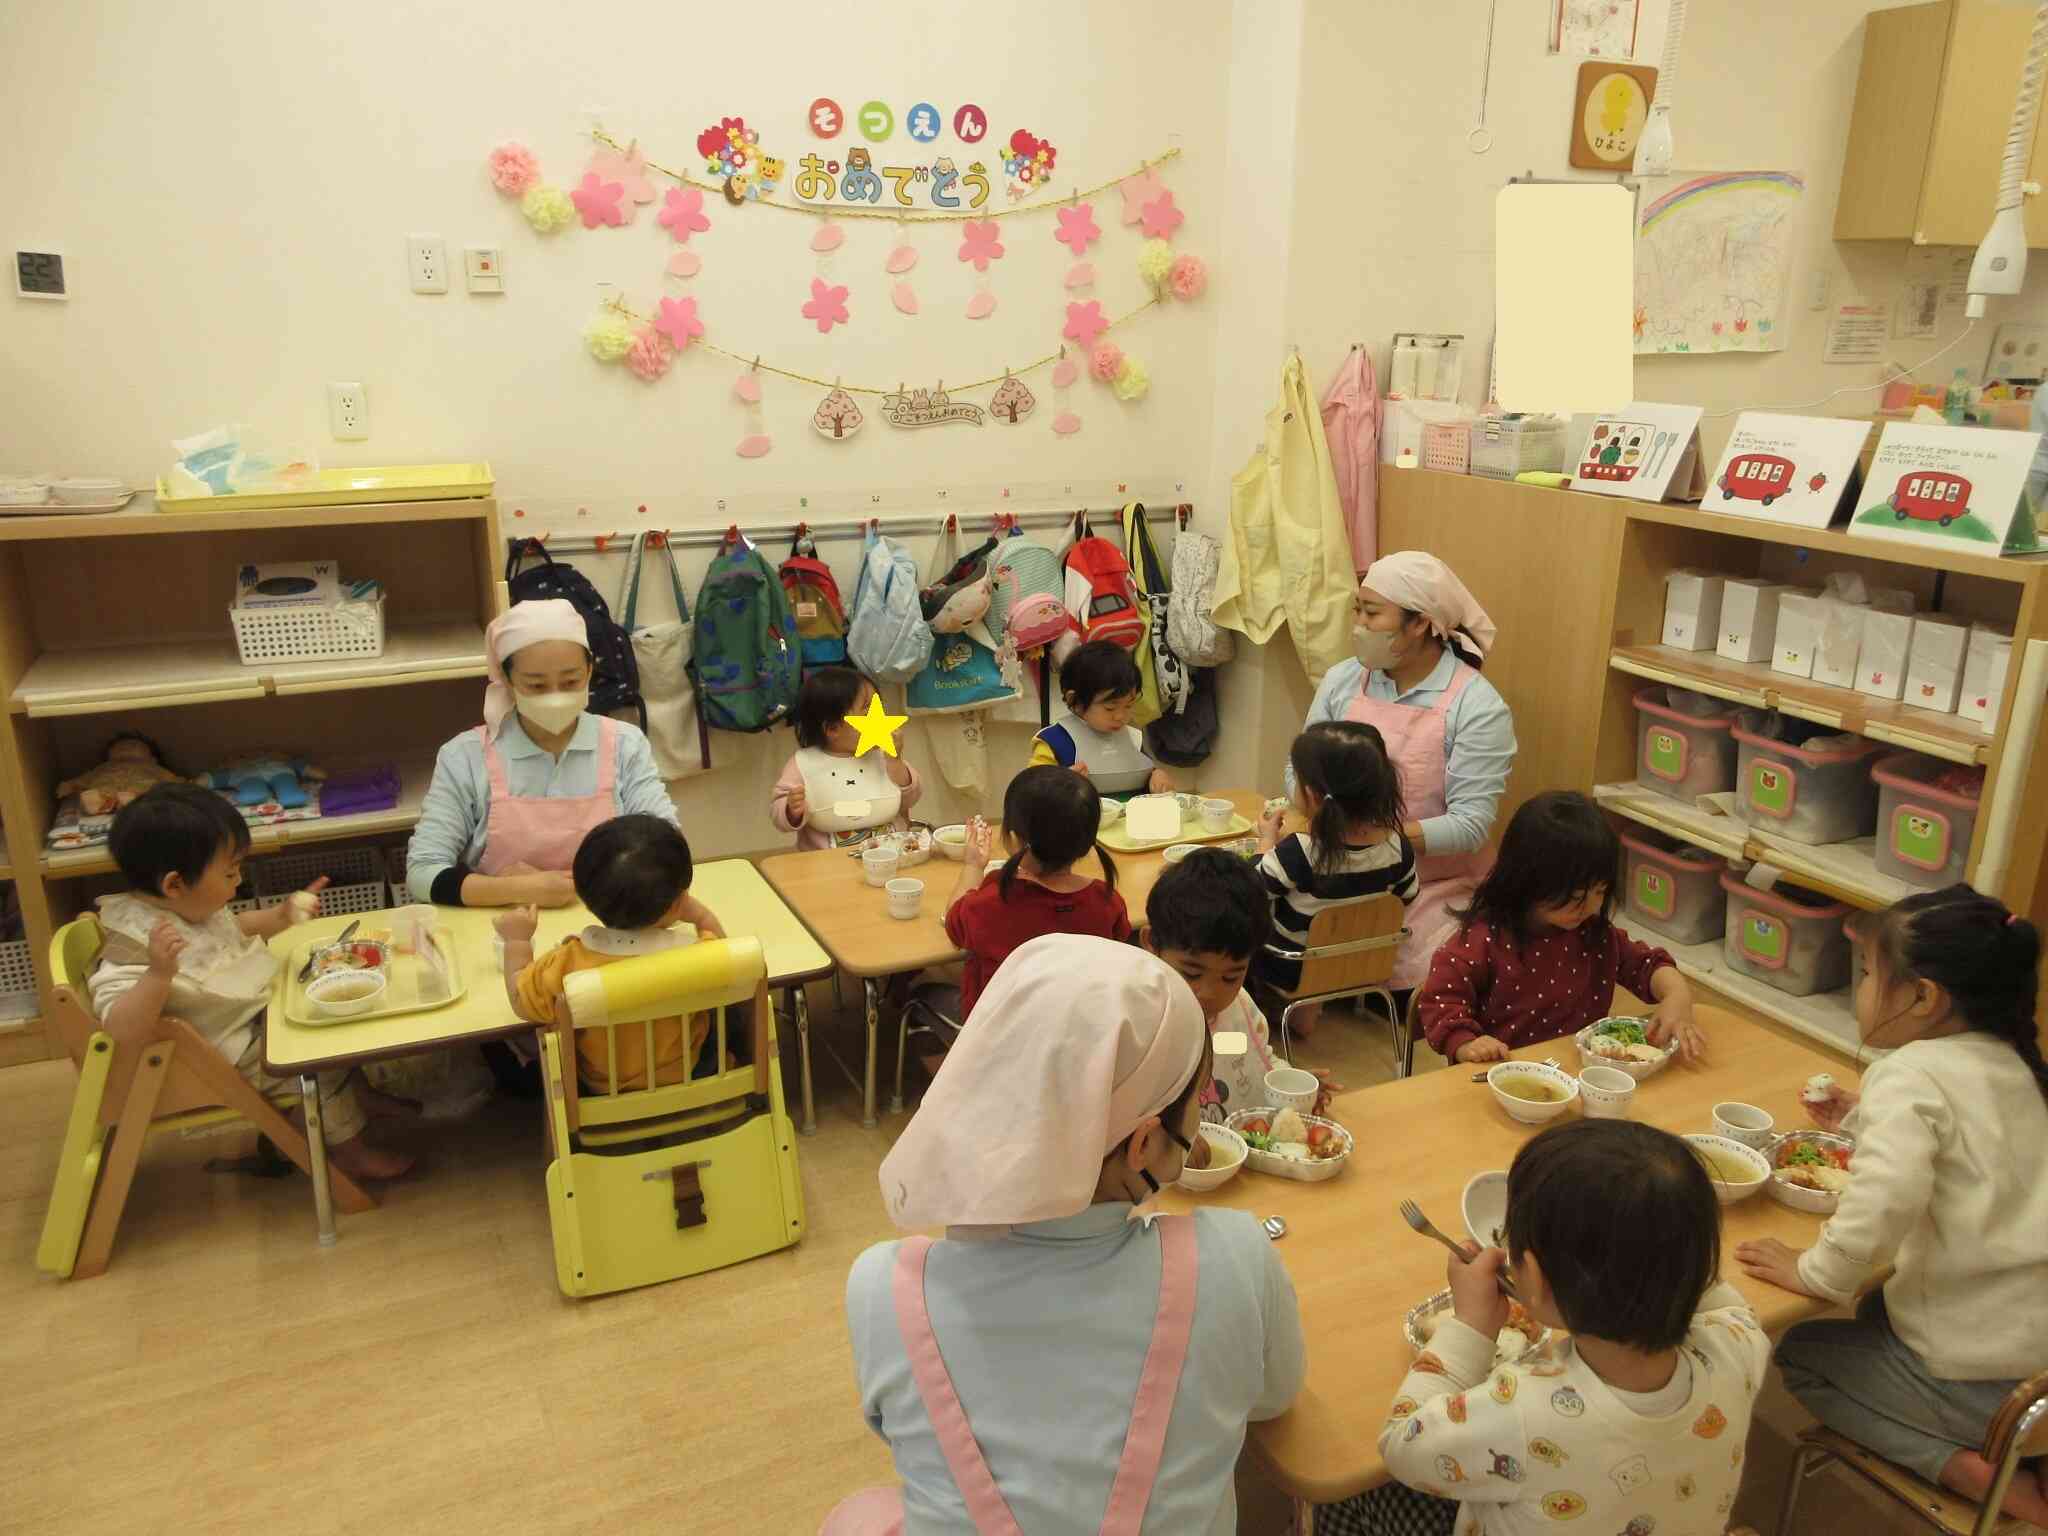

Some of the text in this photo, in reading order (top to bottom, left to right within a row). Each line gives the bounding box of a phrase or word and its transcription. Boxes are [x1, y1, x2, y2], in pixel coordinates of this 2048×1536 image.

[813, 105, 983, 138] そつえん
[1595, 137, 1626, 152] ひよこ
[795, 151, 990, 209] おめでとう
